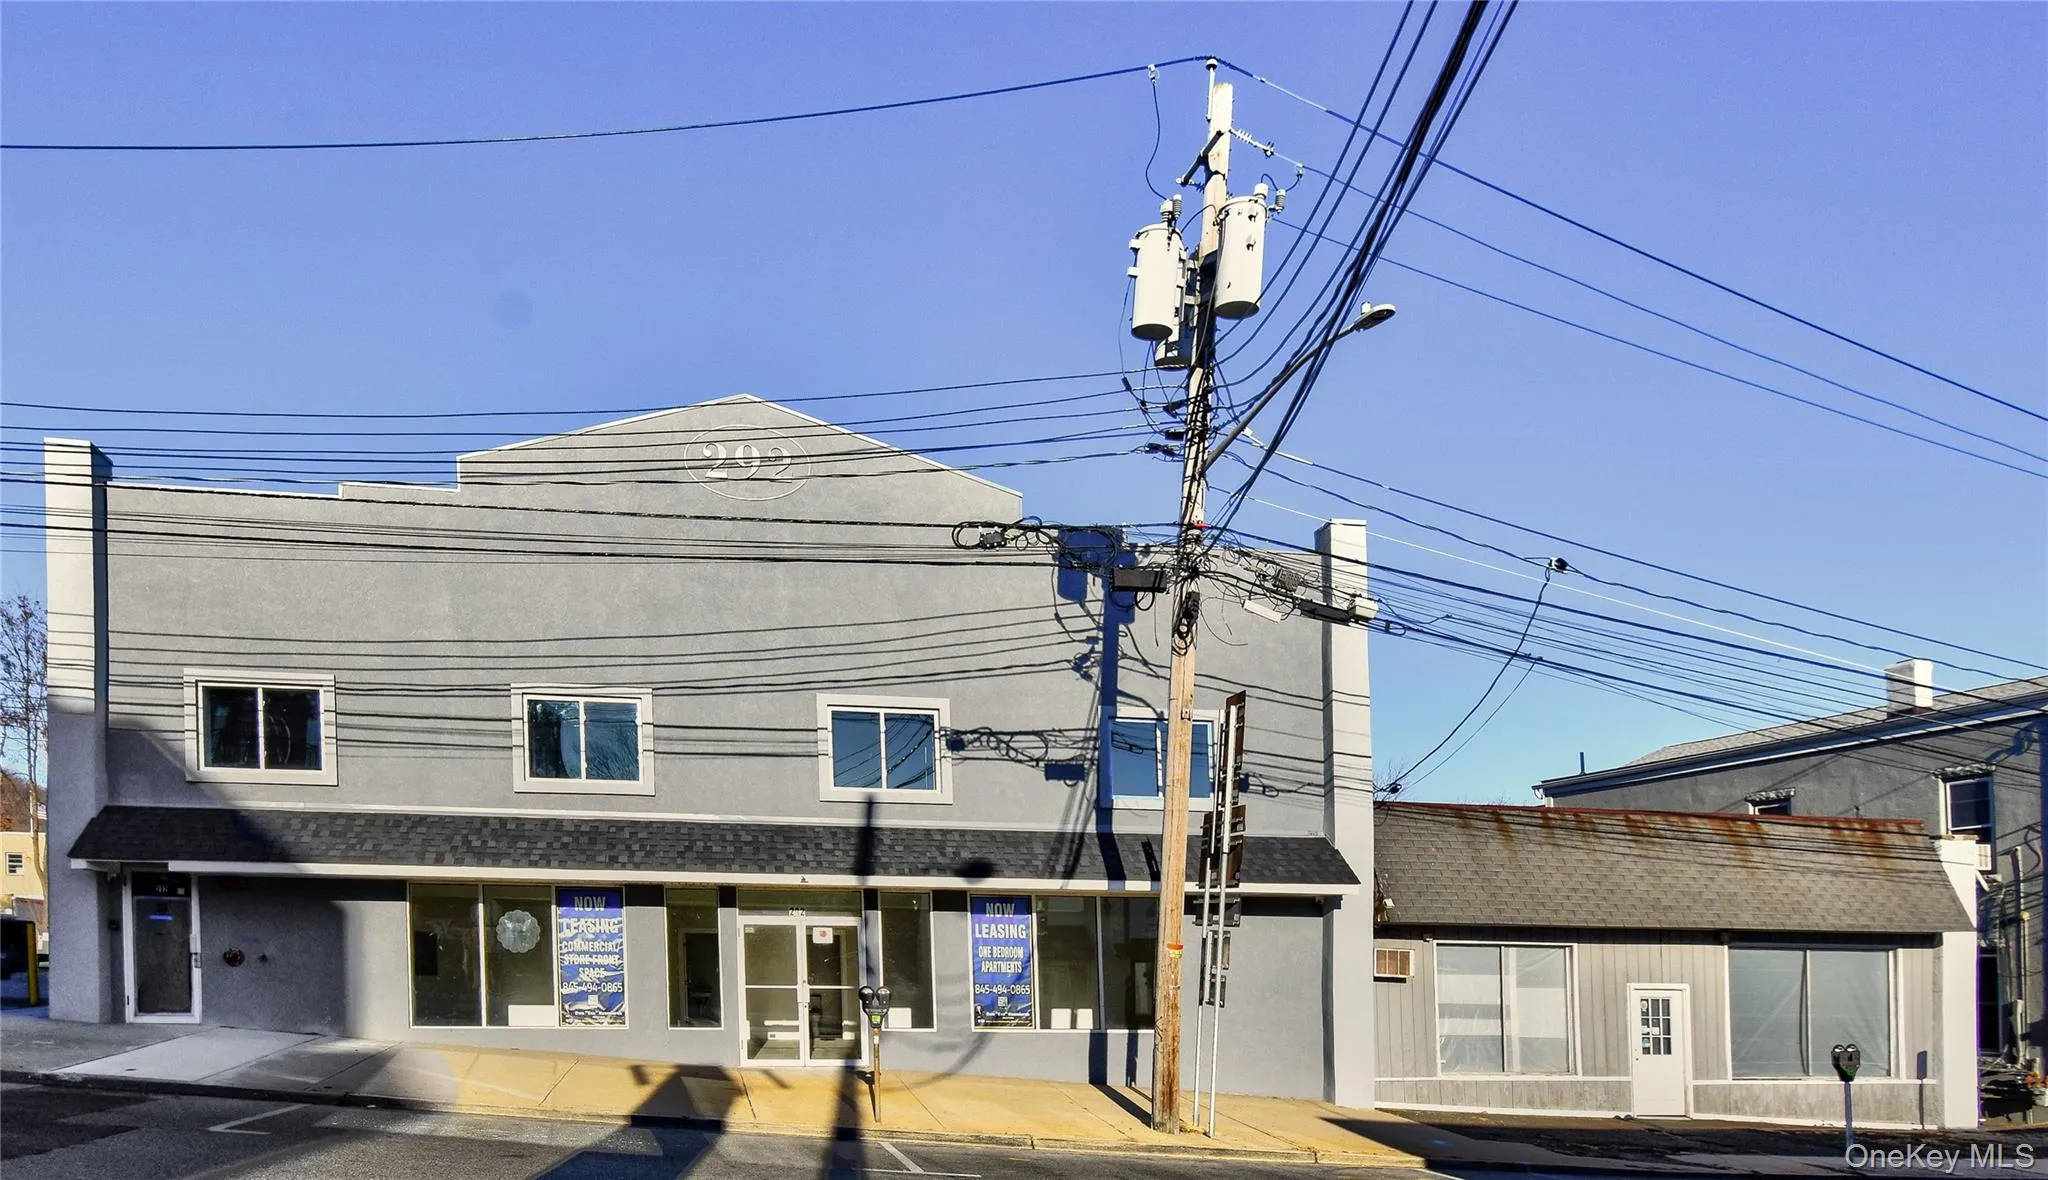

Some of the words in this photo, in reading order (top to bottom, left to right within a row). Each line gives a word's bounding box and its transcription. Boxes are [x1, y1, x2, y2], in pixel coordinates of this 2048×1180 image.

[702, 442, 793, 483] 292
[574, 896, 606, 911] NOW
[985, 902, 1015, 918] NOW
[561, 918, 619, 935] LEASING
[975, 923, 1027, 939] LEASING
[978, 946, 992, 958] ONE
[992, 946, 1024, 959] BEDROOM
[578, 967, 606, 978] SPACE
[981, 960, 1023, 973] APARTMENTS
[562, 982, 623, 993] 845-494-0865
[974, 984, 1031, 995] 845-494-0865
